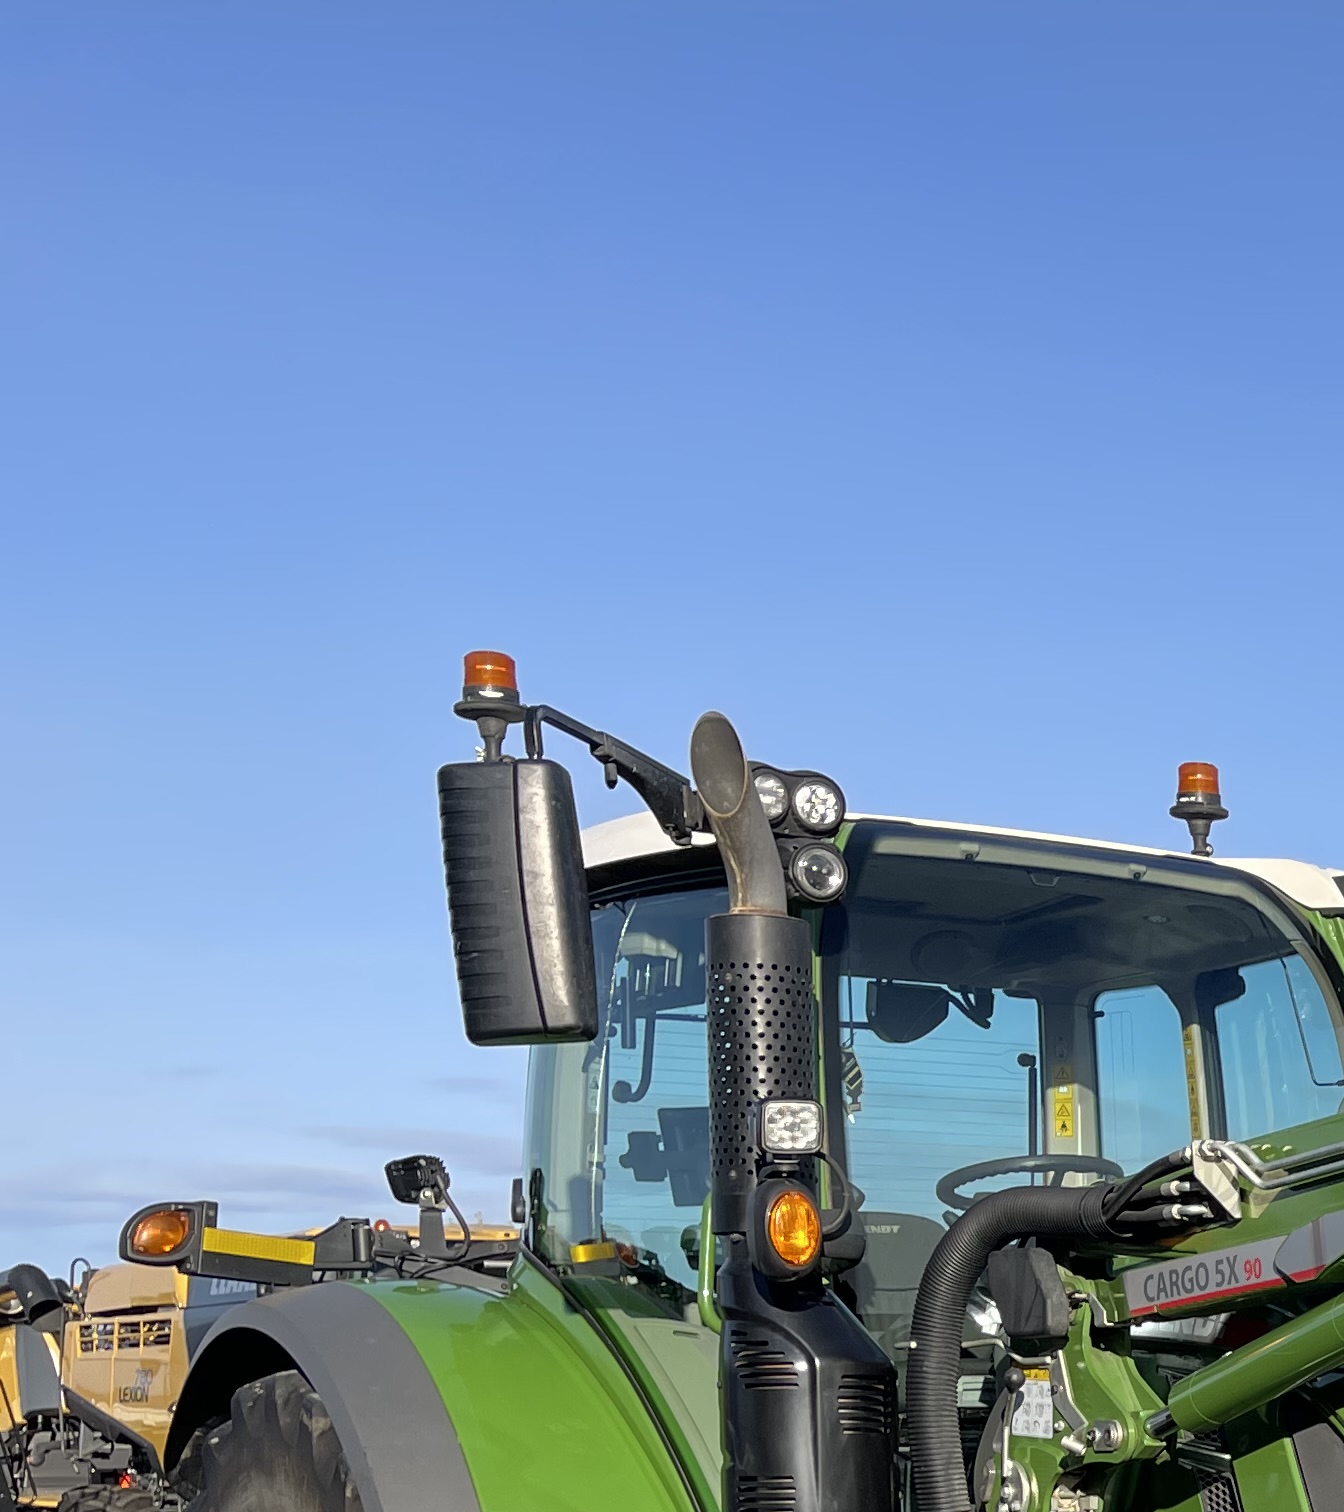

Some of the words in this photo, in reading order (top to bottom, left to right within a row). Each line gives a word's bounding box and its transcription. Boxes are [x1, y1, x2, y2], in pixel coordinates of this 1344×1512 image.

[1144, 1262, 1210, 1302] CARGO
[1215, 1255, 1240, 1288] 5X
[1244, 1258, 1262, 1281] 90
